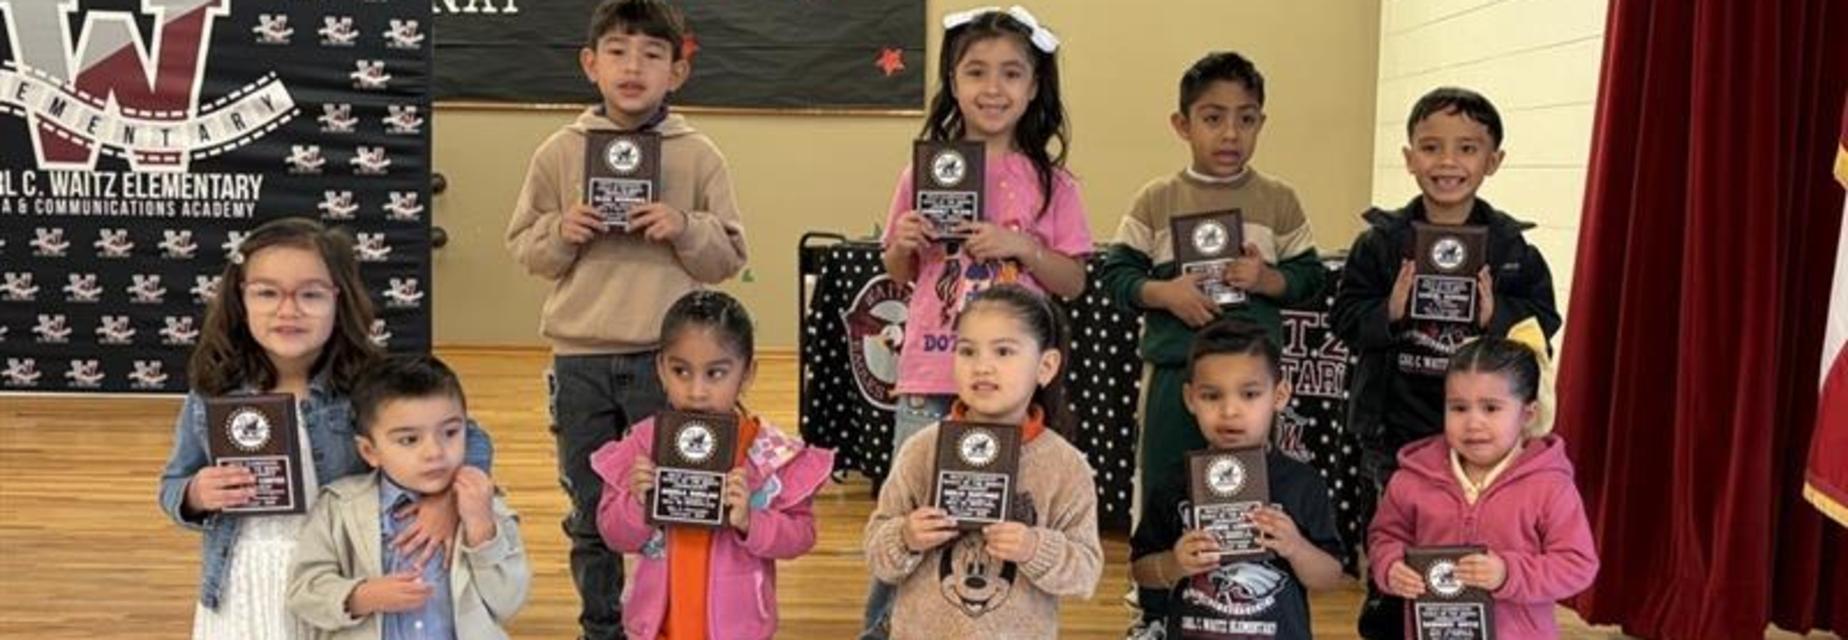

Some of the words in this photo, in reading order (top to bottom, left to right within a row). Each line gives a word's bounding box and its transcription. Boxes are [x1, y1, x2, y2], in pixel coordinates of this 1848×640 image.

[22, 169, 45, 197] C.
[50, 169, 117, 198] WAITZ
[122, 171, 263, 201] ELEMENTARY
[18, 197, 28, 215] &
[34, 198, 177, 217] COMMUNICATIONS
[181, 201, 256, 218] ACADEMY
